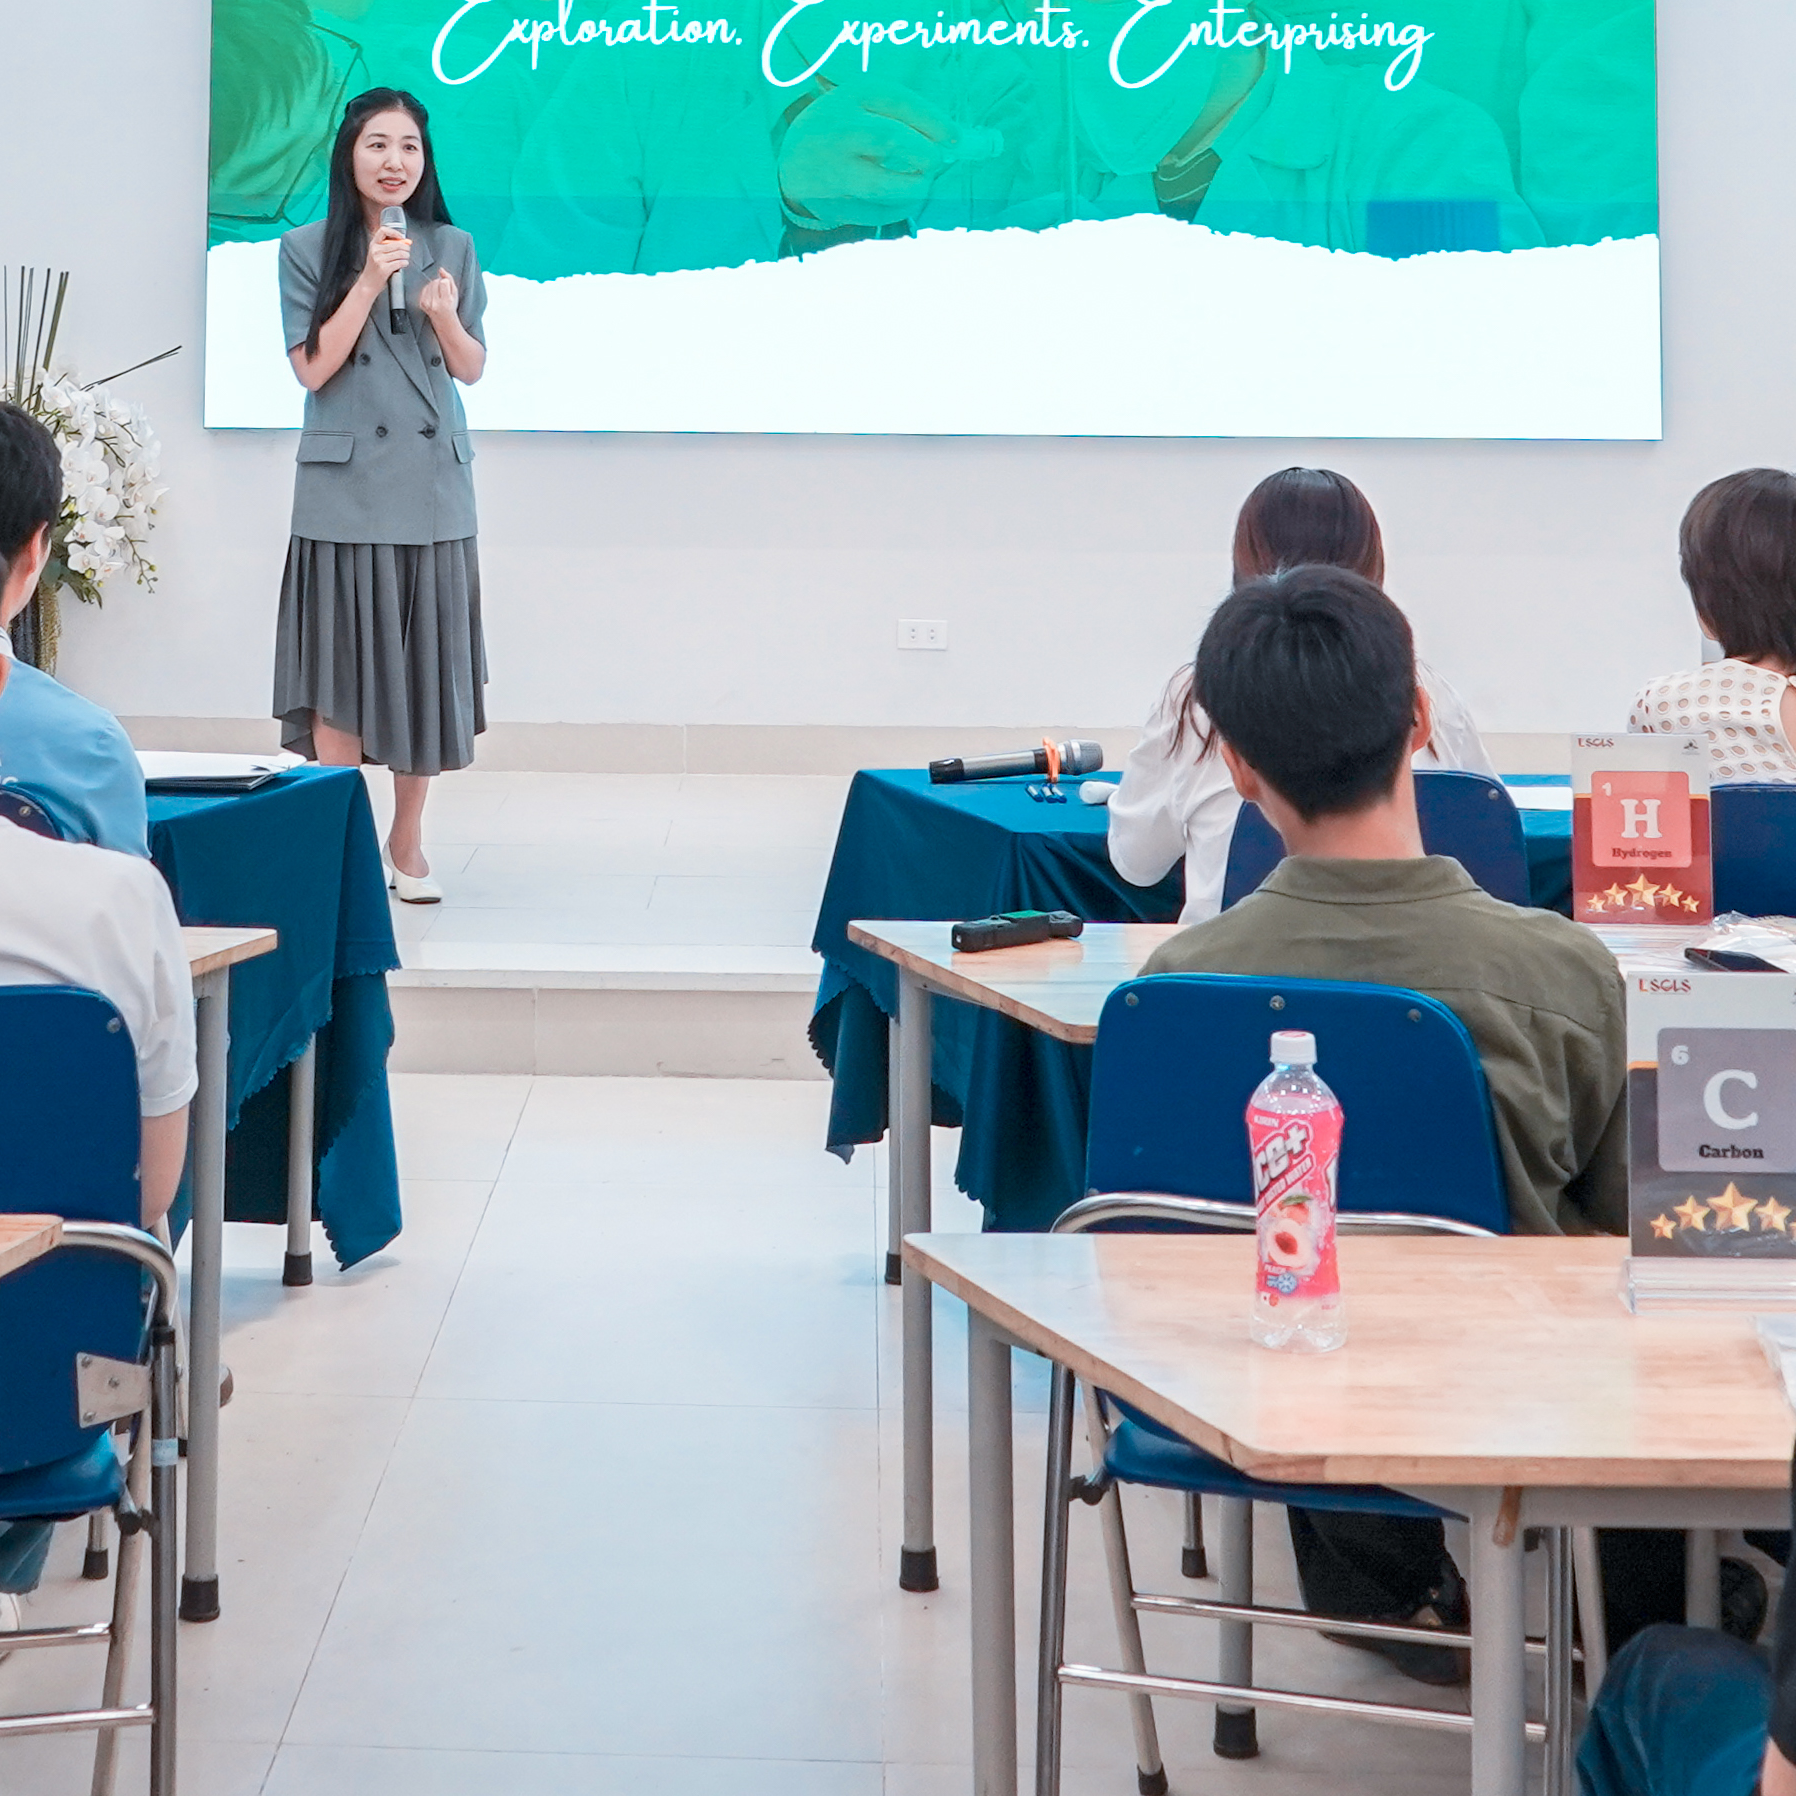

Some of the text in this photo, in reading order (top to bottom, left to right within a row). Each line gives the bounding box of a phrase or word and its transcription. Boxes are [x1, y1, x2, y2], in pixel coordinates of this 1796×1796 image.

[1602, 782, 1612, 796] 1
[1620, 798, 1662, 839] H
[1611, 847, 1673, 860] Hydrogen
[1671, 1045, 1690, 1066] 6
[1703, 1068, 1759, 1130] C
[1698, 1143, 1764, 1160] Carbon
